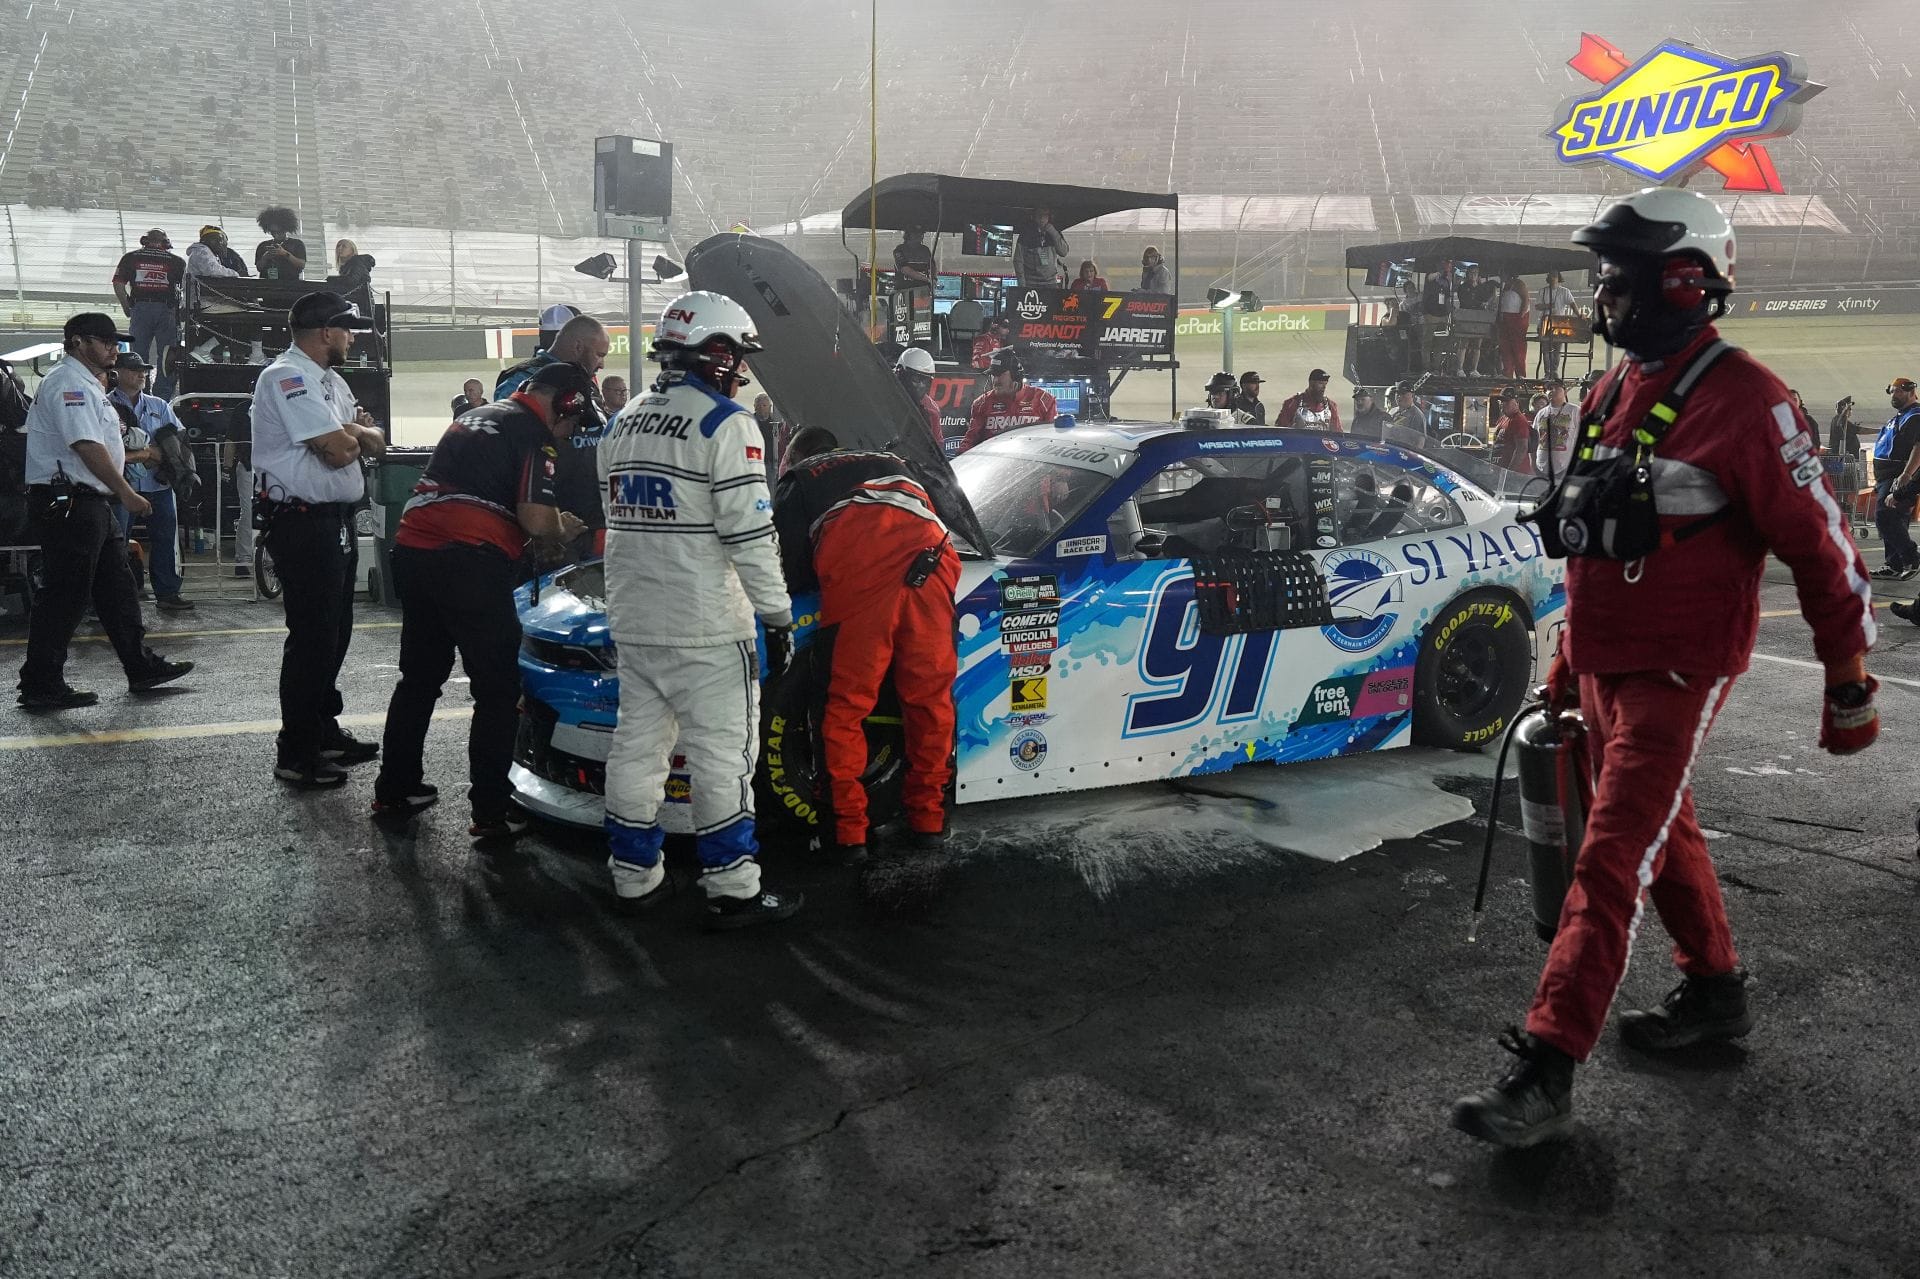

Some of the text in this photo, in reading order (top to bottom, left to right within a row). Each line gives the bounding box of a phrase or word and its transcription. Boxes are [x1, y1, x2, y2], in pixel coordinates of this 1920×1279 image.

[1566, 70, 1774, 151] SUNOCO
[631, 225, 645, 235] 19
[1016, 301, 1048, 314] Arby's
[1102, 297, 1123, 319] 7
[1125, 302, 1168, 312] BRANDT
[1765, 299, 1828, 311] CUP SERIES
[1837, 297, 1881, 312] xfinity
[1239, 314, 1310, 332] EchoPark
[1019, 324, 1086, 339] BRANDT
[1100, 327, 1167, 343] JARRETT
[1030, 341, 1058, 349] Professional
[611, 413, 694, 441] OFFICIAL
[1198, 439, 1283, 449] MASON MAGGIO
[1315, 498, 1333, 510] WIX
[640, 506, 677, 520] TEAM
[1072, 537, 1101, 547] NASCAR
[1402, 539, 1447, 585] SI
[1001, 612, 1059, 628] COMETIC
[1434, 603, 1513, 650] GOODYEAR
[1004, 630, 1048, 643] LINCOLN
[1363, 623, 1388, 645] COMPANY
[1014, 641, 1053, 652] WELDERS
[1121, 564, 1282, 740] 91
[1008, 665, 1045, 678] MSD
[1368, 678, 1409, 689] SUCCESS
[1314, 686, 1346, 702] free
[1012, 702, 1046, 711] KENNAMETAL
[1316, 695, 1350, 715] rent
[1463, 717, 1504, 742] EAGLE
[1014, 731, 1043, 746] CHAMPION
[1014, 753, 1044, 769] IRRIGATION
